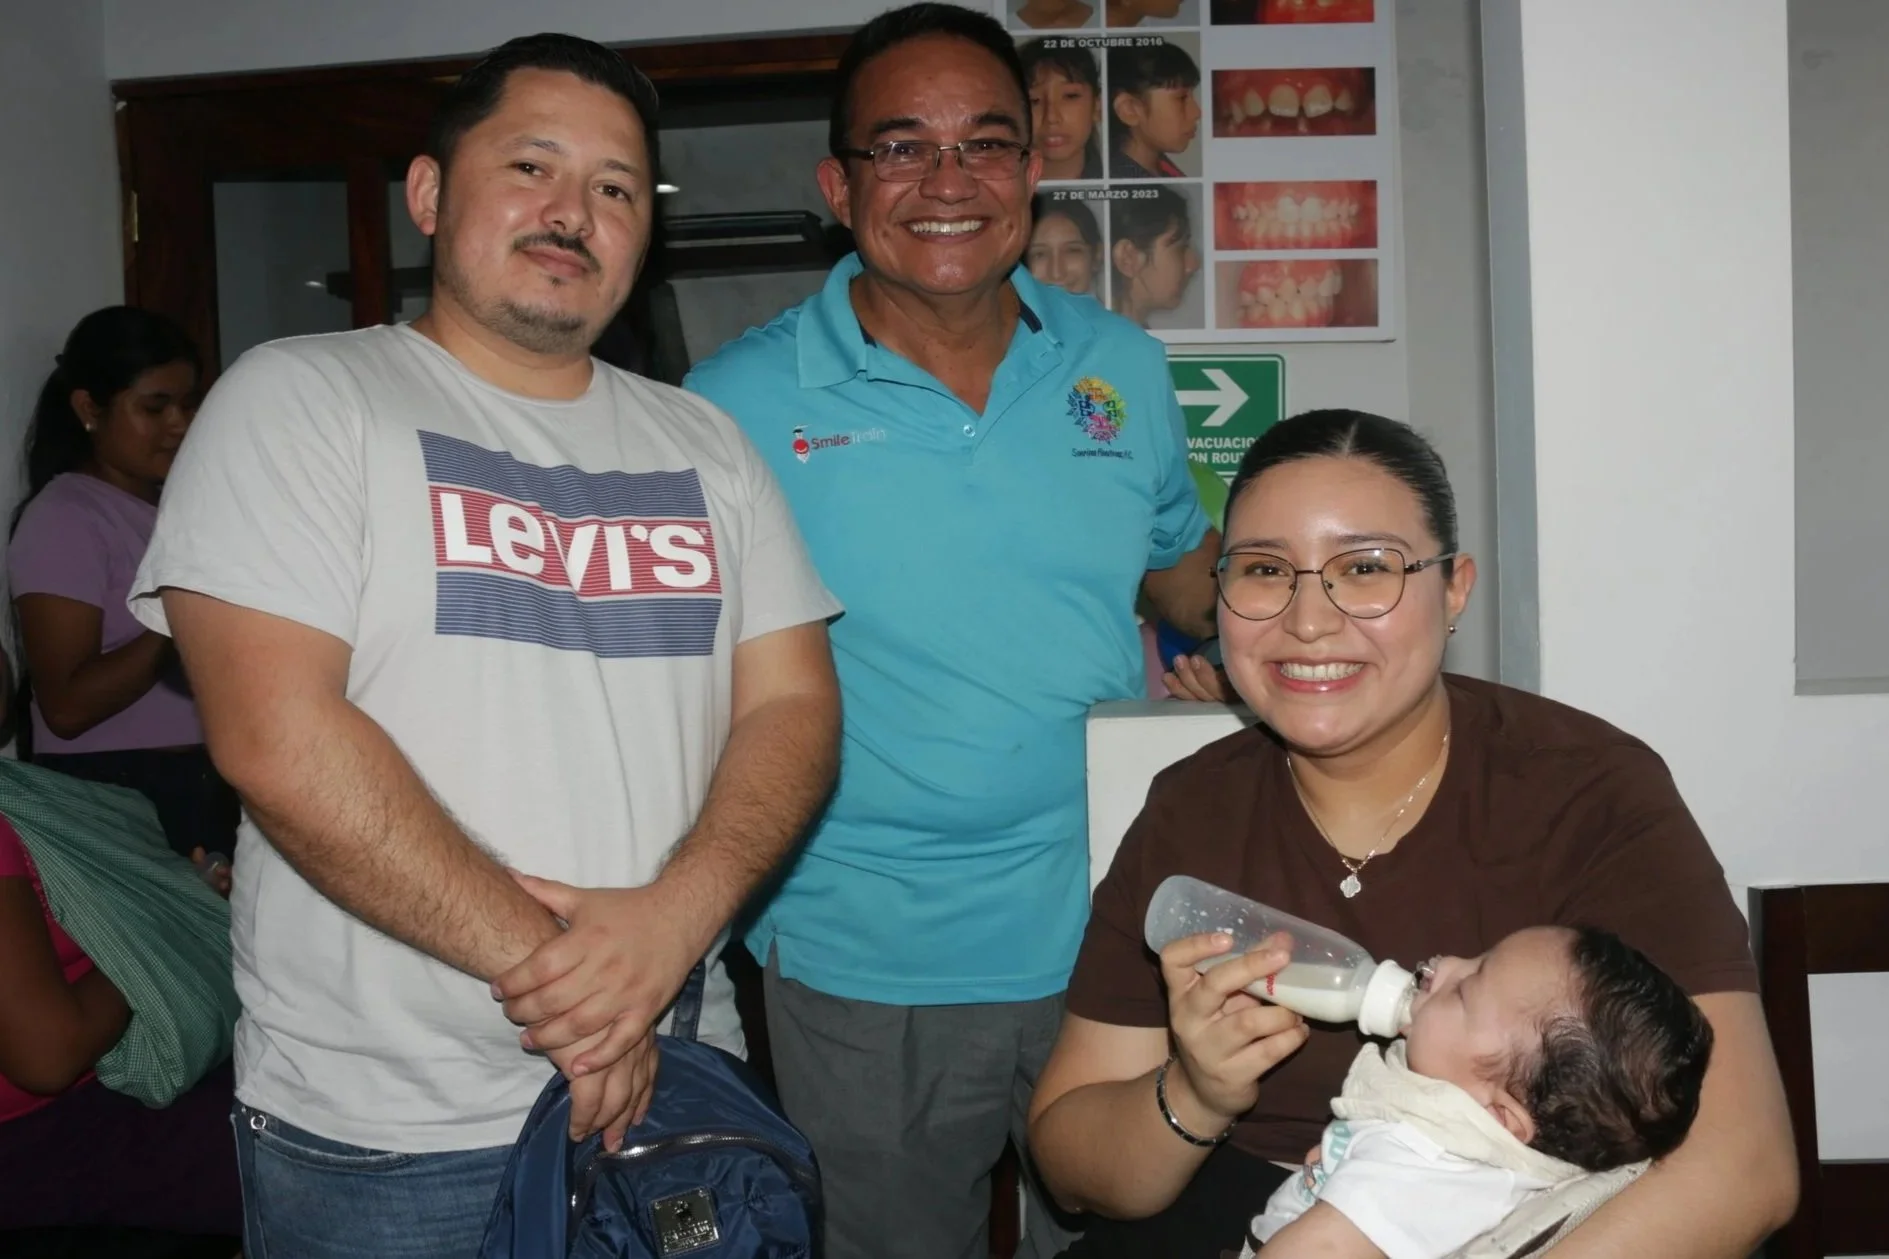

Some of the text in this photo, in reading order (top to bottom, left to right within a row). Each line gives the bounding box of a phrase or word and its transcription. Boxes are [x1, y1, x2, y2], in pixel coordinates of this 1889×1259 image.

[1043, 37, 1163, 48] 22 DE OCTUBRE 2016
[1053, 189, 1159, 200] 27 DE MARZO 2023
[1186, 437, 1257, 449] VACUACIO
